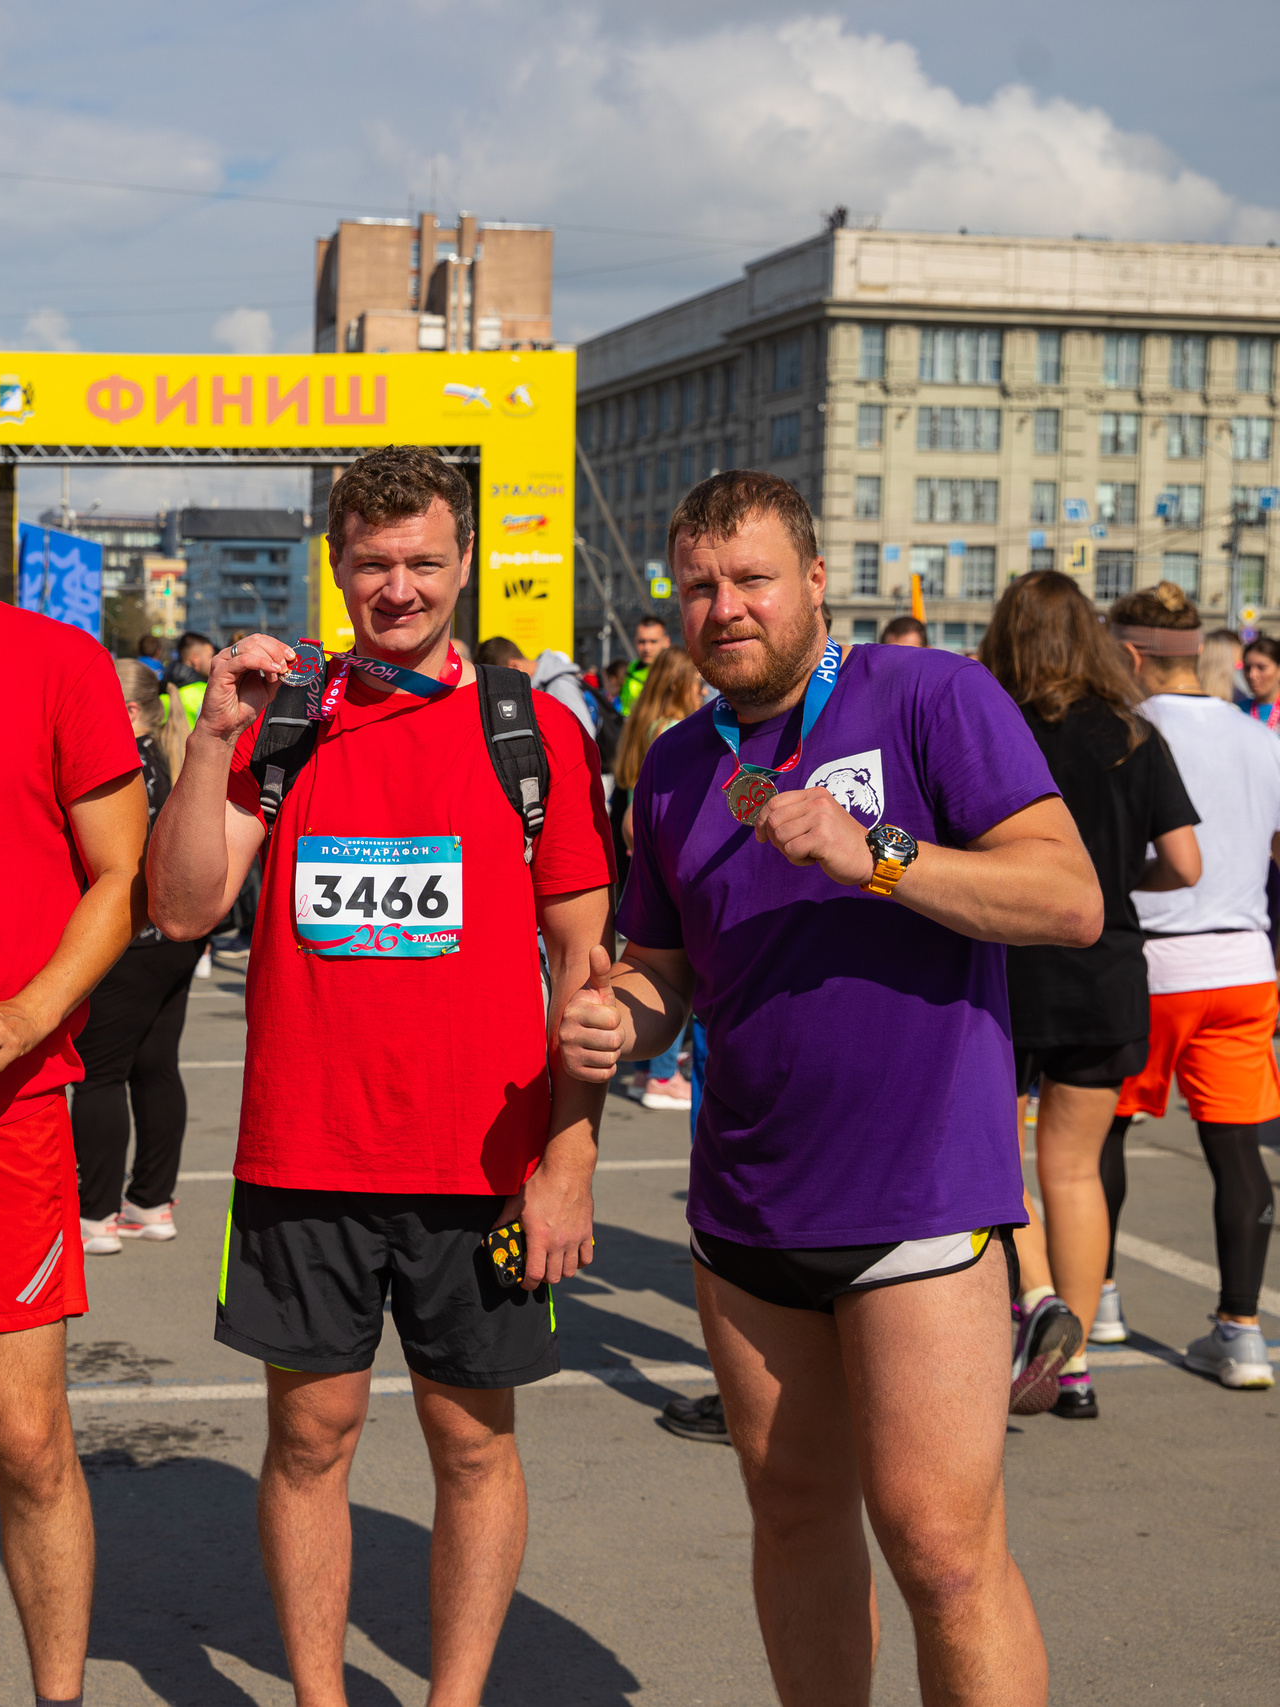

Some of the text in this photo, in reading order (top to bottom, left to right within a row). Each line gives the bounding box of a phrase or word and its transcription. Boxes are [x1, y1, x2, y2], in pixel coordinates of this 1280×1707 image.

[86, 374, 387, 425] ФИНИШ
[321, 846, 429, 857] ПОЛУМАРАФОН
[313, 875, 449, 919] 3466
[350, 923, 403, 953] 26
[412, 933, 457, 943] ЭТАЛОН
